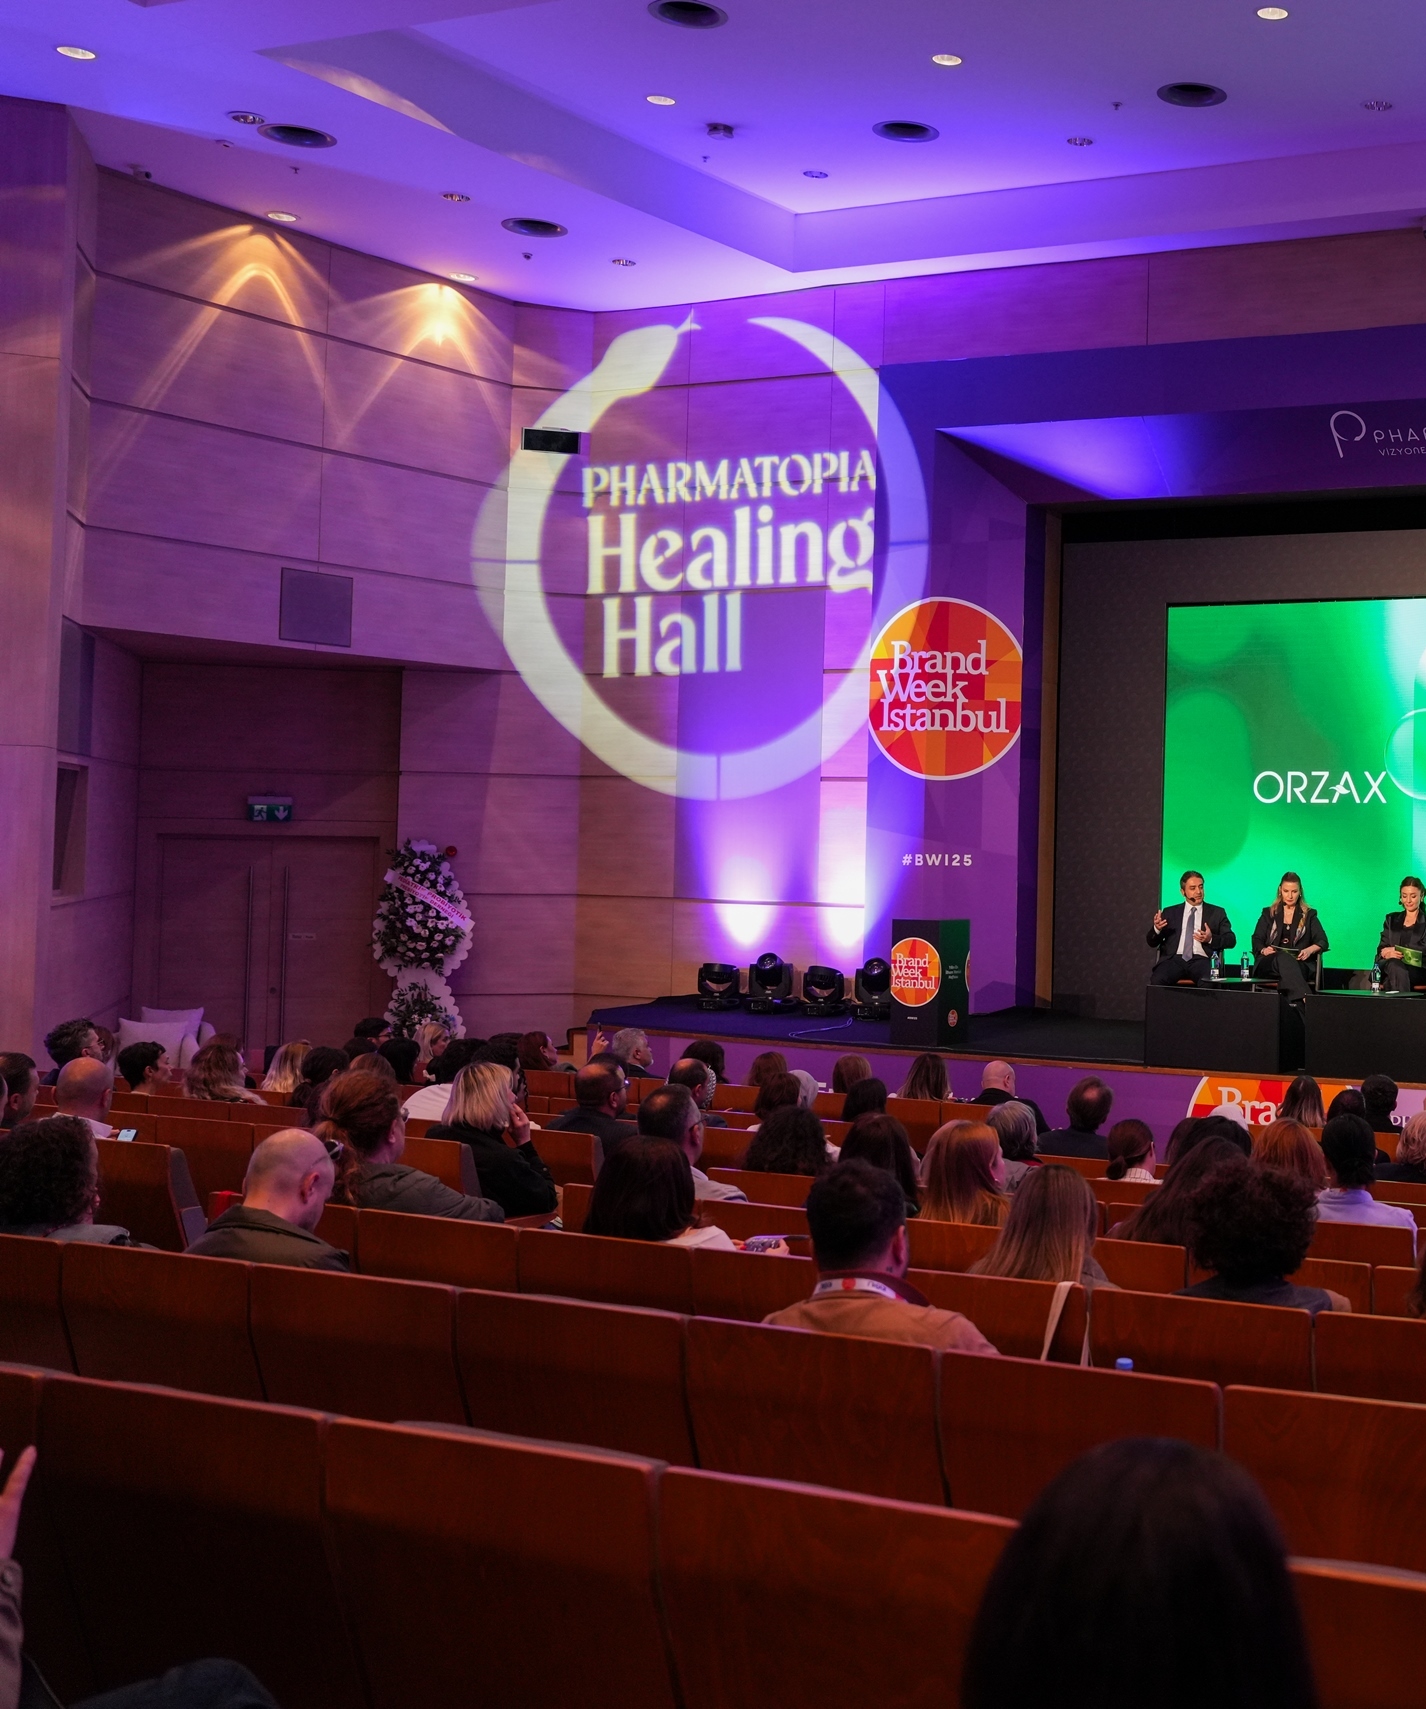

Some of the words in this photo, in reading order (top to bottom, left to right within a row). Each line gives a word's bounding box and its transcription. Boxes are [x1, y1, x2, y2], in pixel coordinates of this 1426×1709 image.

[582, 449, 876, 507] PHARMATOPIA
[586, 504, 875, 595] Healing
[601, 592, 744, 678] Hall
[891, 639, 990, 676] Brand
[877, 667, 970, 704] Week
[880, 698, 1009, 734] Istanbul
[1253, 770, 1387, 805] ORZAX
[902, 853, 973, 867] #BWI25
[891, 964, 923, 978] Week
[896, 953, 929, 967] Brand
[891, 976, 936, 989] Istanbul
[1217, 1086, 1282, 1126] Bra
